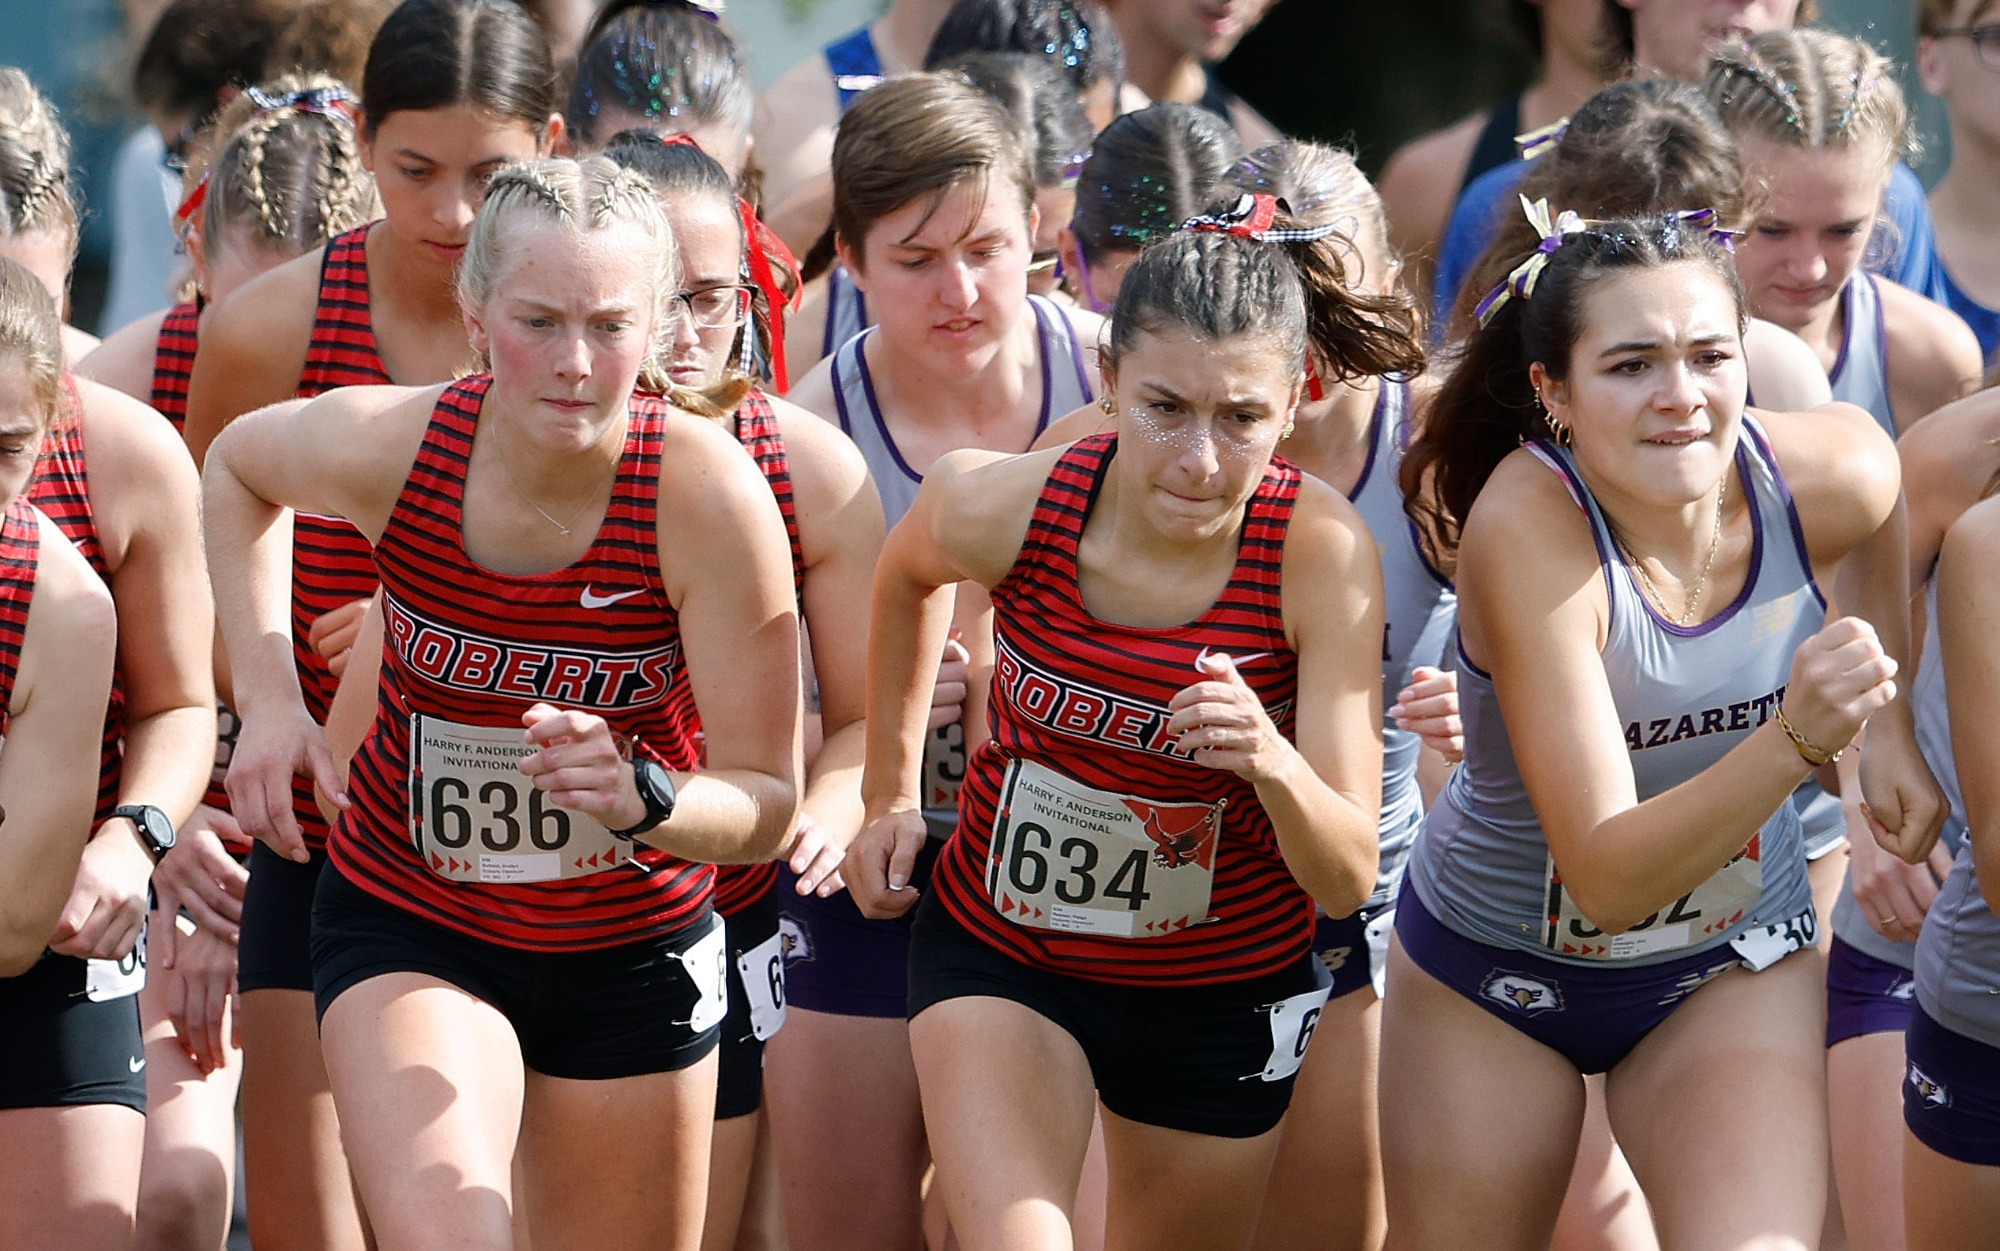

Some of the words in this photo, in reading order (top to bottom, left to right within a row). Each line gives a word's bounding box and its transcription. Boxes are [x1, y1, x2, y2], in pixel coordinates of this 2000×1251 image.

[388, 602, 676, 706] ROBERTS
[1624, 683, 1790, 750] AZARET
[424, 737, 461, 752] HARRY
[464, 746, 474, 754] F.
[443, 755, 518, 771] INVITATIONA
[431, 777, 571, 852] 636
[1018, 779, 1053, 802] HARRY
[1056, 796, 1064, 807] F.
[1067, 801, 1133, 823] ANDERSON
[1033, 802, 1112, 835] INVITATIONAL
[1009, 821, 1150, 911] 634
